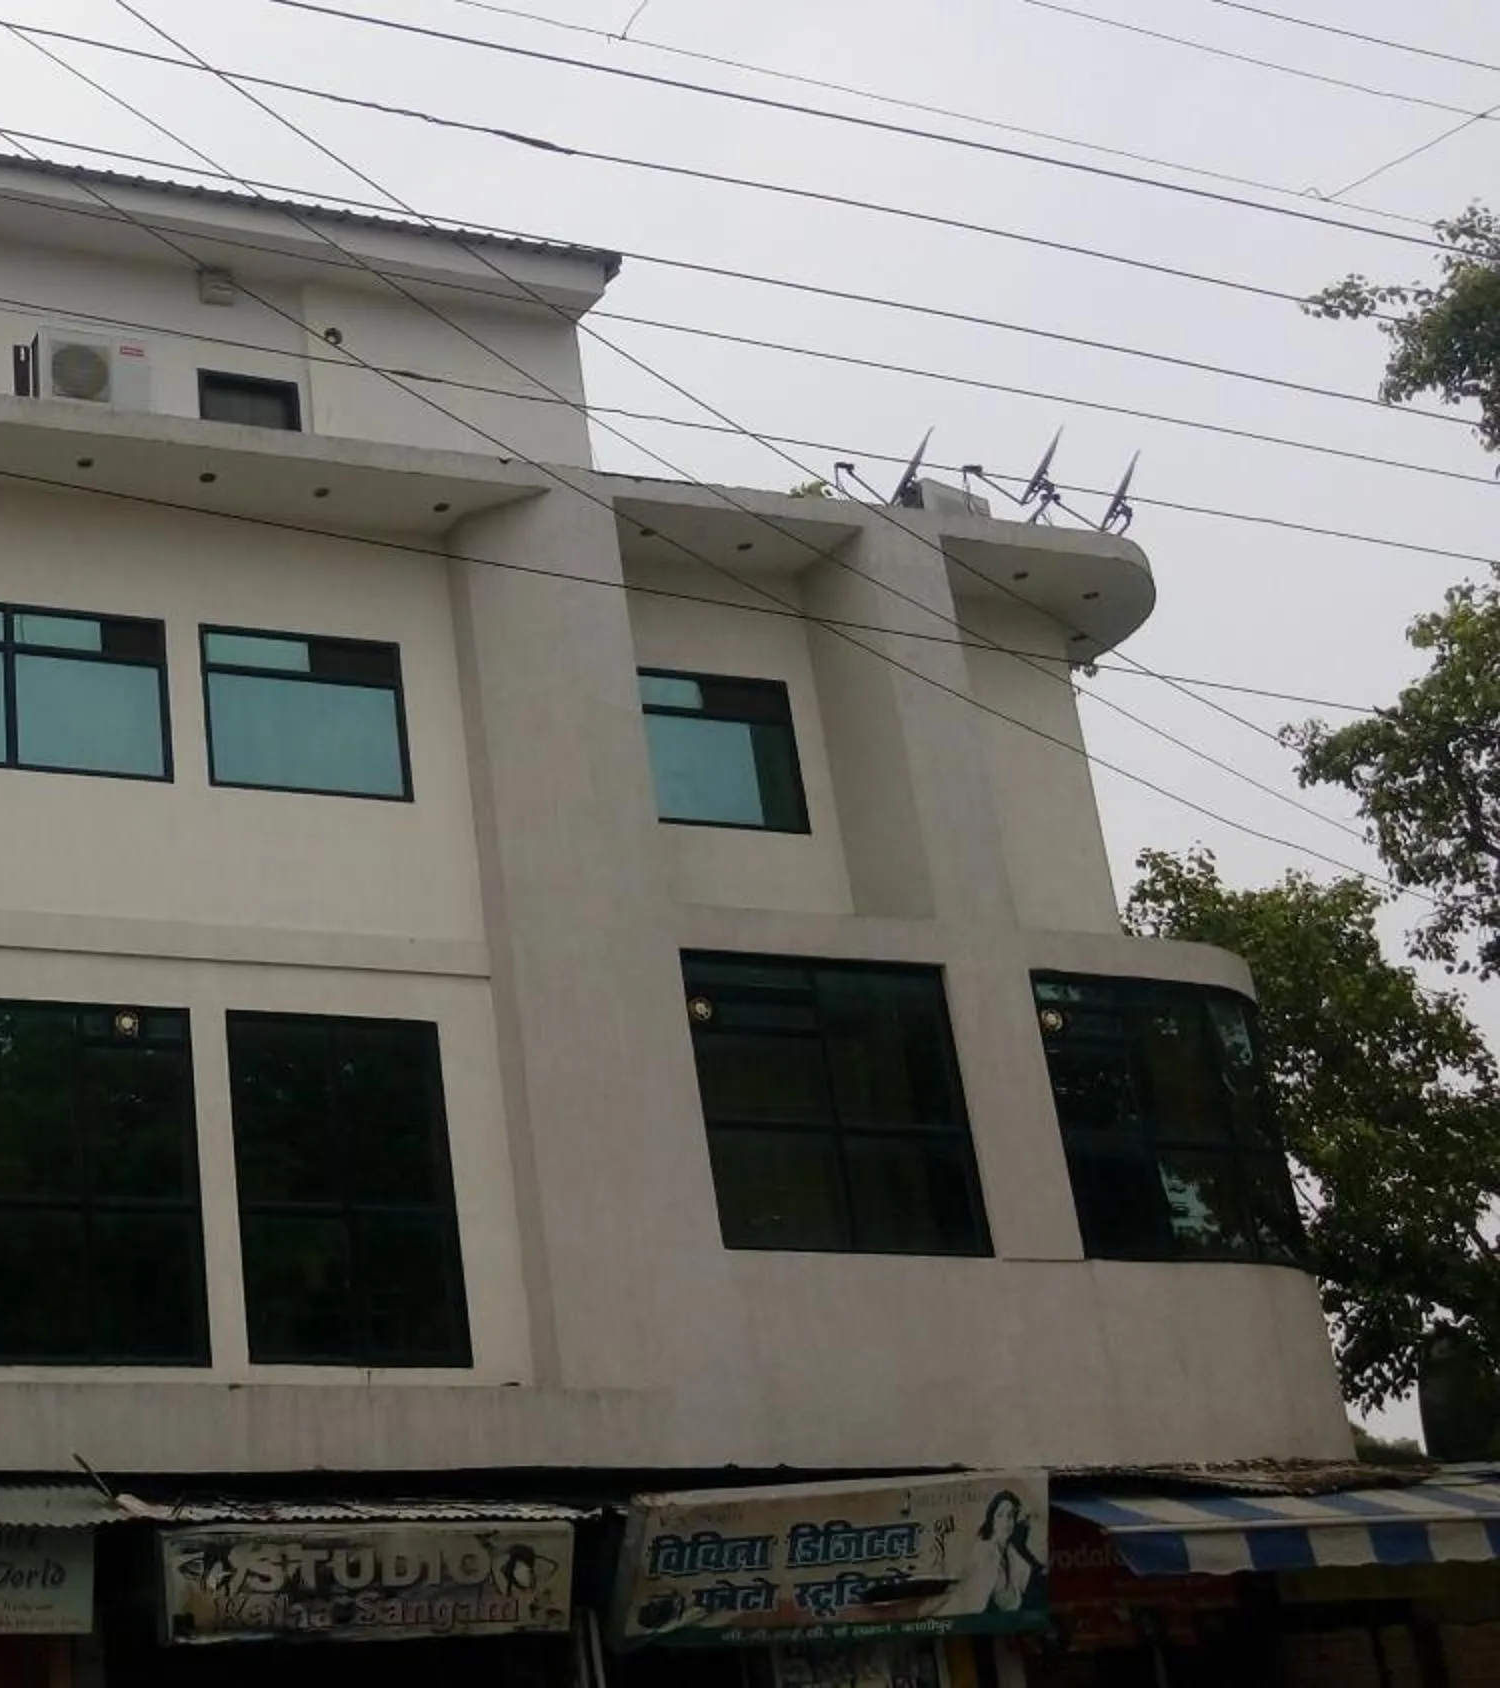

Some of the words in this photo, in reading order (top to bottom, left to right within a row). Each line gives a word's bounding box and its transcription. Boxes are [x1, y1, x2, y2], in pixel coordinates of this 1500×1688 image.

[233, 1543, 490, 1593] STUDIO
[787, 1519, 922, 1568] डिजिटल
[353, 1590, 520, 1633] Sangam
